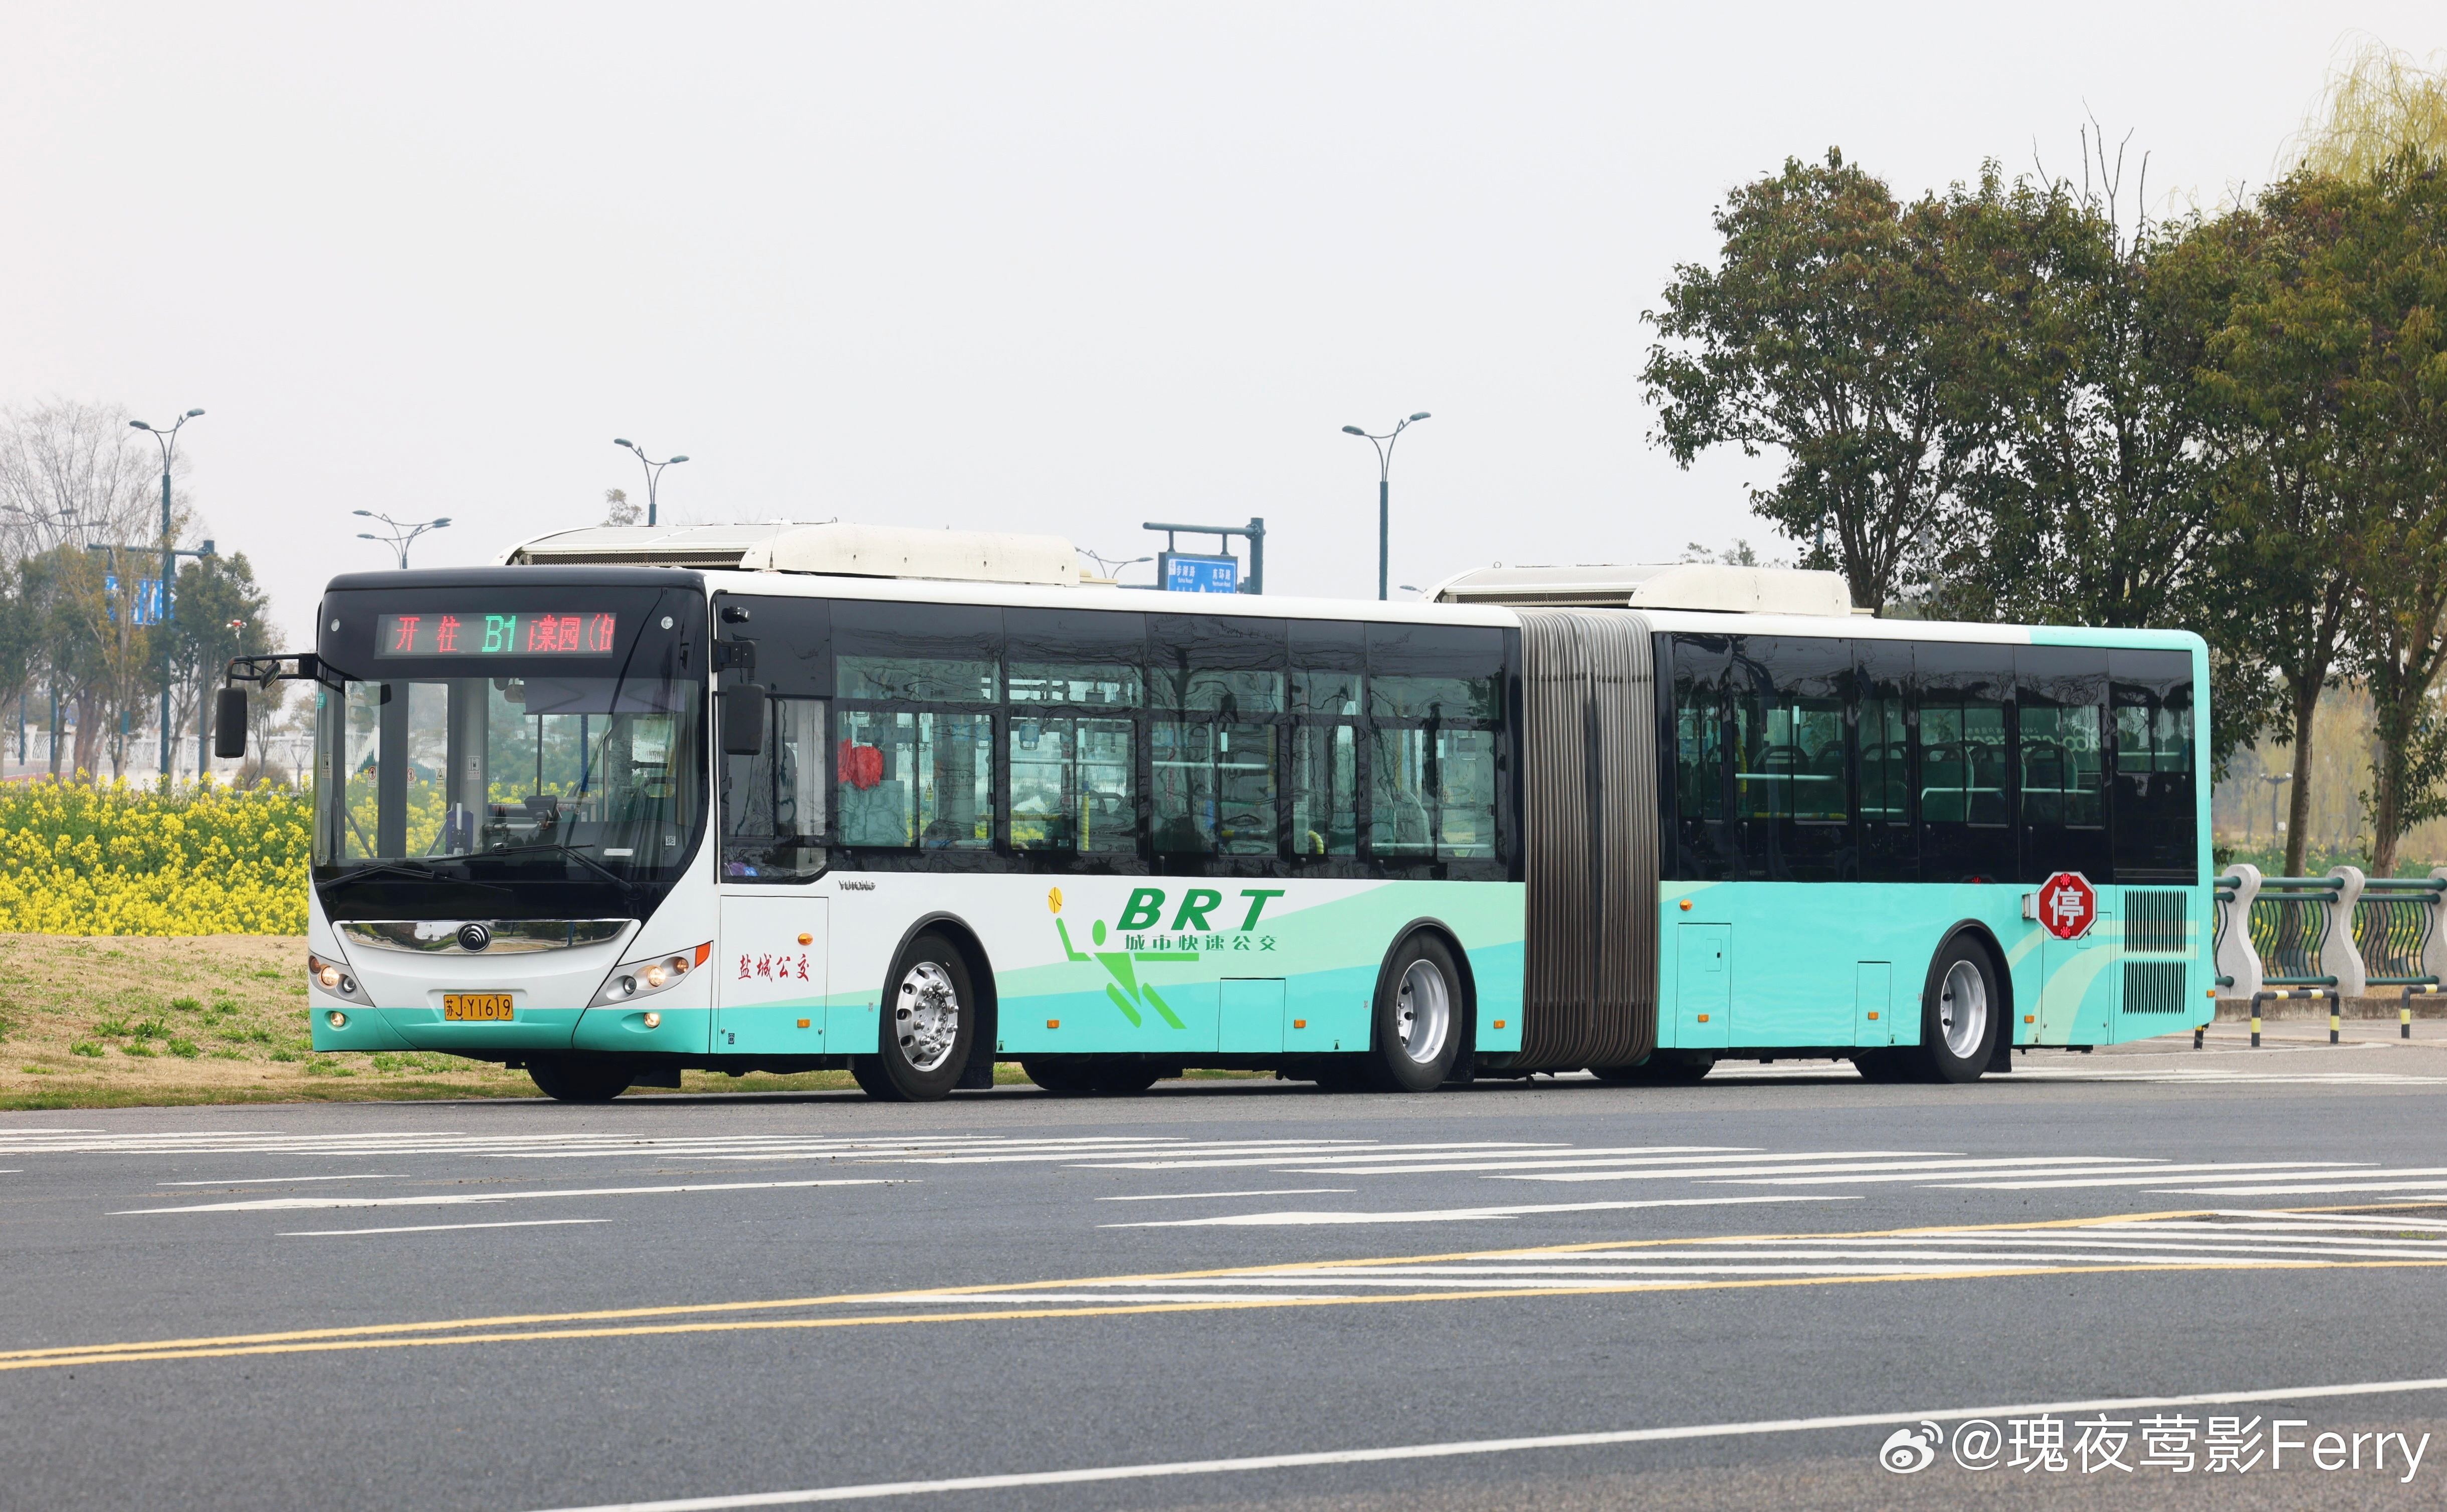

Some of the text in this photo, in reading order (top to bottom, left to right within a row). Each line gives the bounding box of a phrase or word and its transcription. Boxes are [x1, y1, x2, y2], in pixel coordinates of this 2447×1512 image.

[482, 615, 517, 653] B1
[838, 880, 876, 891] YUTONG
[1116, 888, 1286, 931] BRT
[2049, 886, 2084, 927] 停
[1124, 934, 1277, 951] 城市快速公交
[738, 953, 810, 983] 盐城公交
